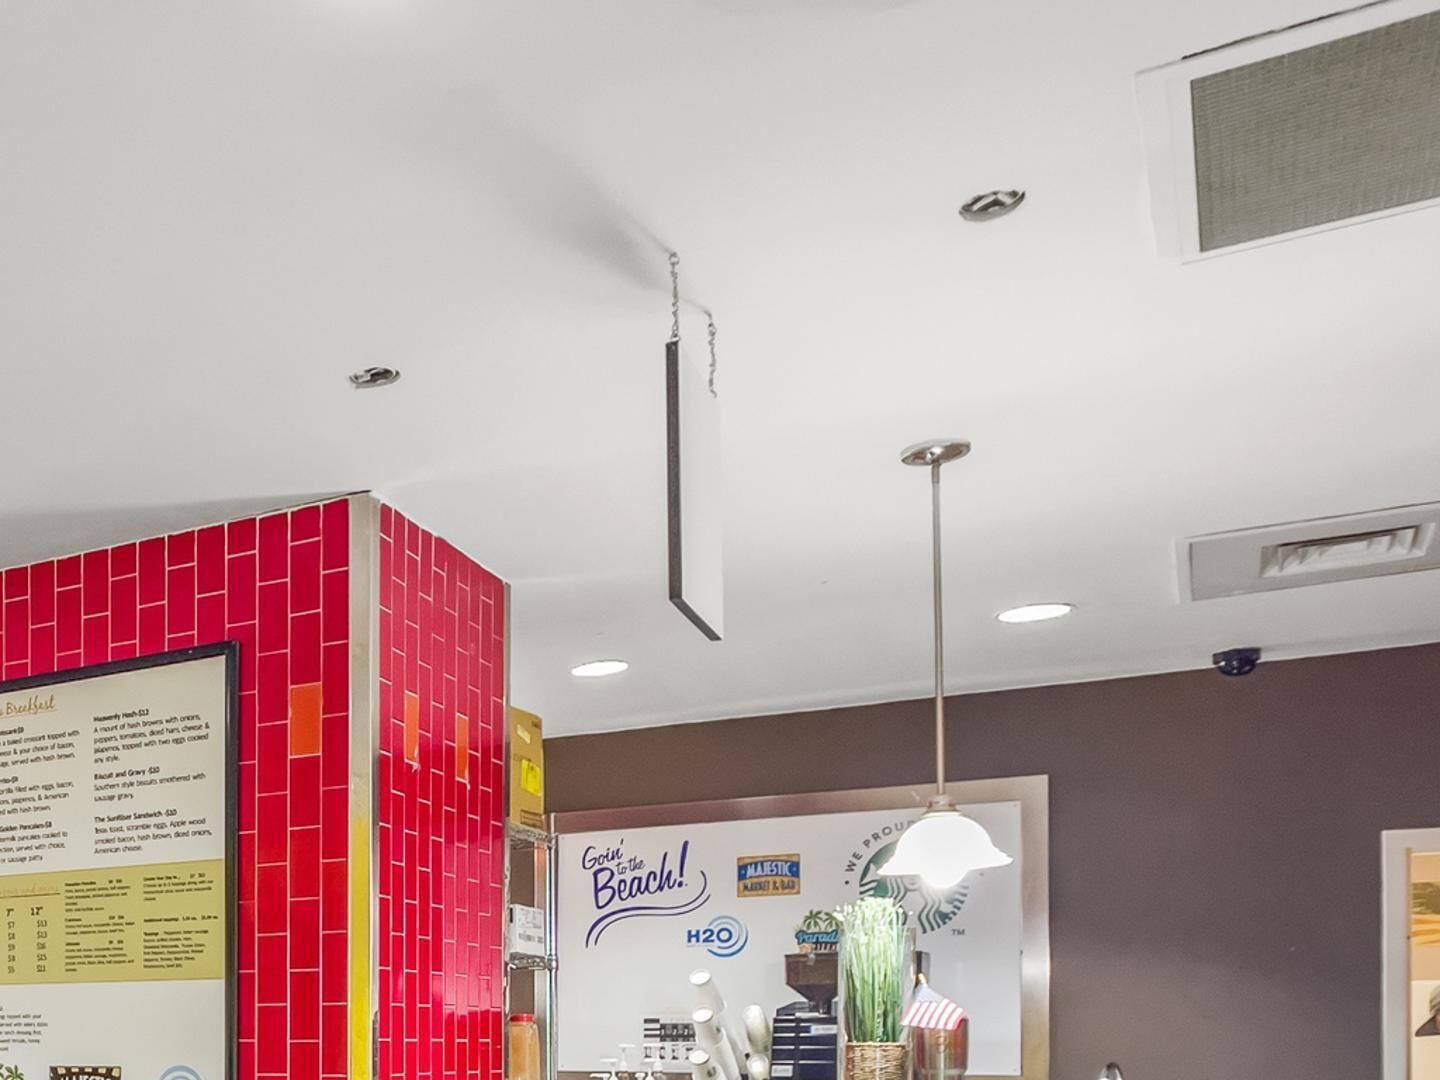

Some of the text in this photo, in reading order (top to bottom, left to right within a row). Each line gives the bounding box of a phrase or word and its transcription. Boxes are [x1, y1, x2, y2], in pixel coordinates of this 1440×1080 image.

[616, 856, 645, 875] to the
[746, 861, 792, 877] MAJESTIC
[845, 852, 863, 872] WE
[593, 840, 689, 909] Beach!
[687, 928, 733, 944] H2O
